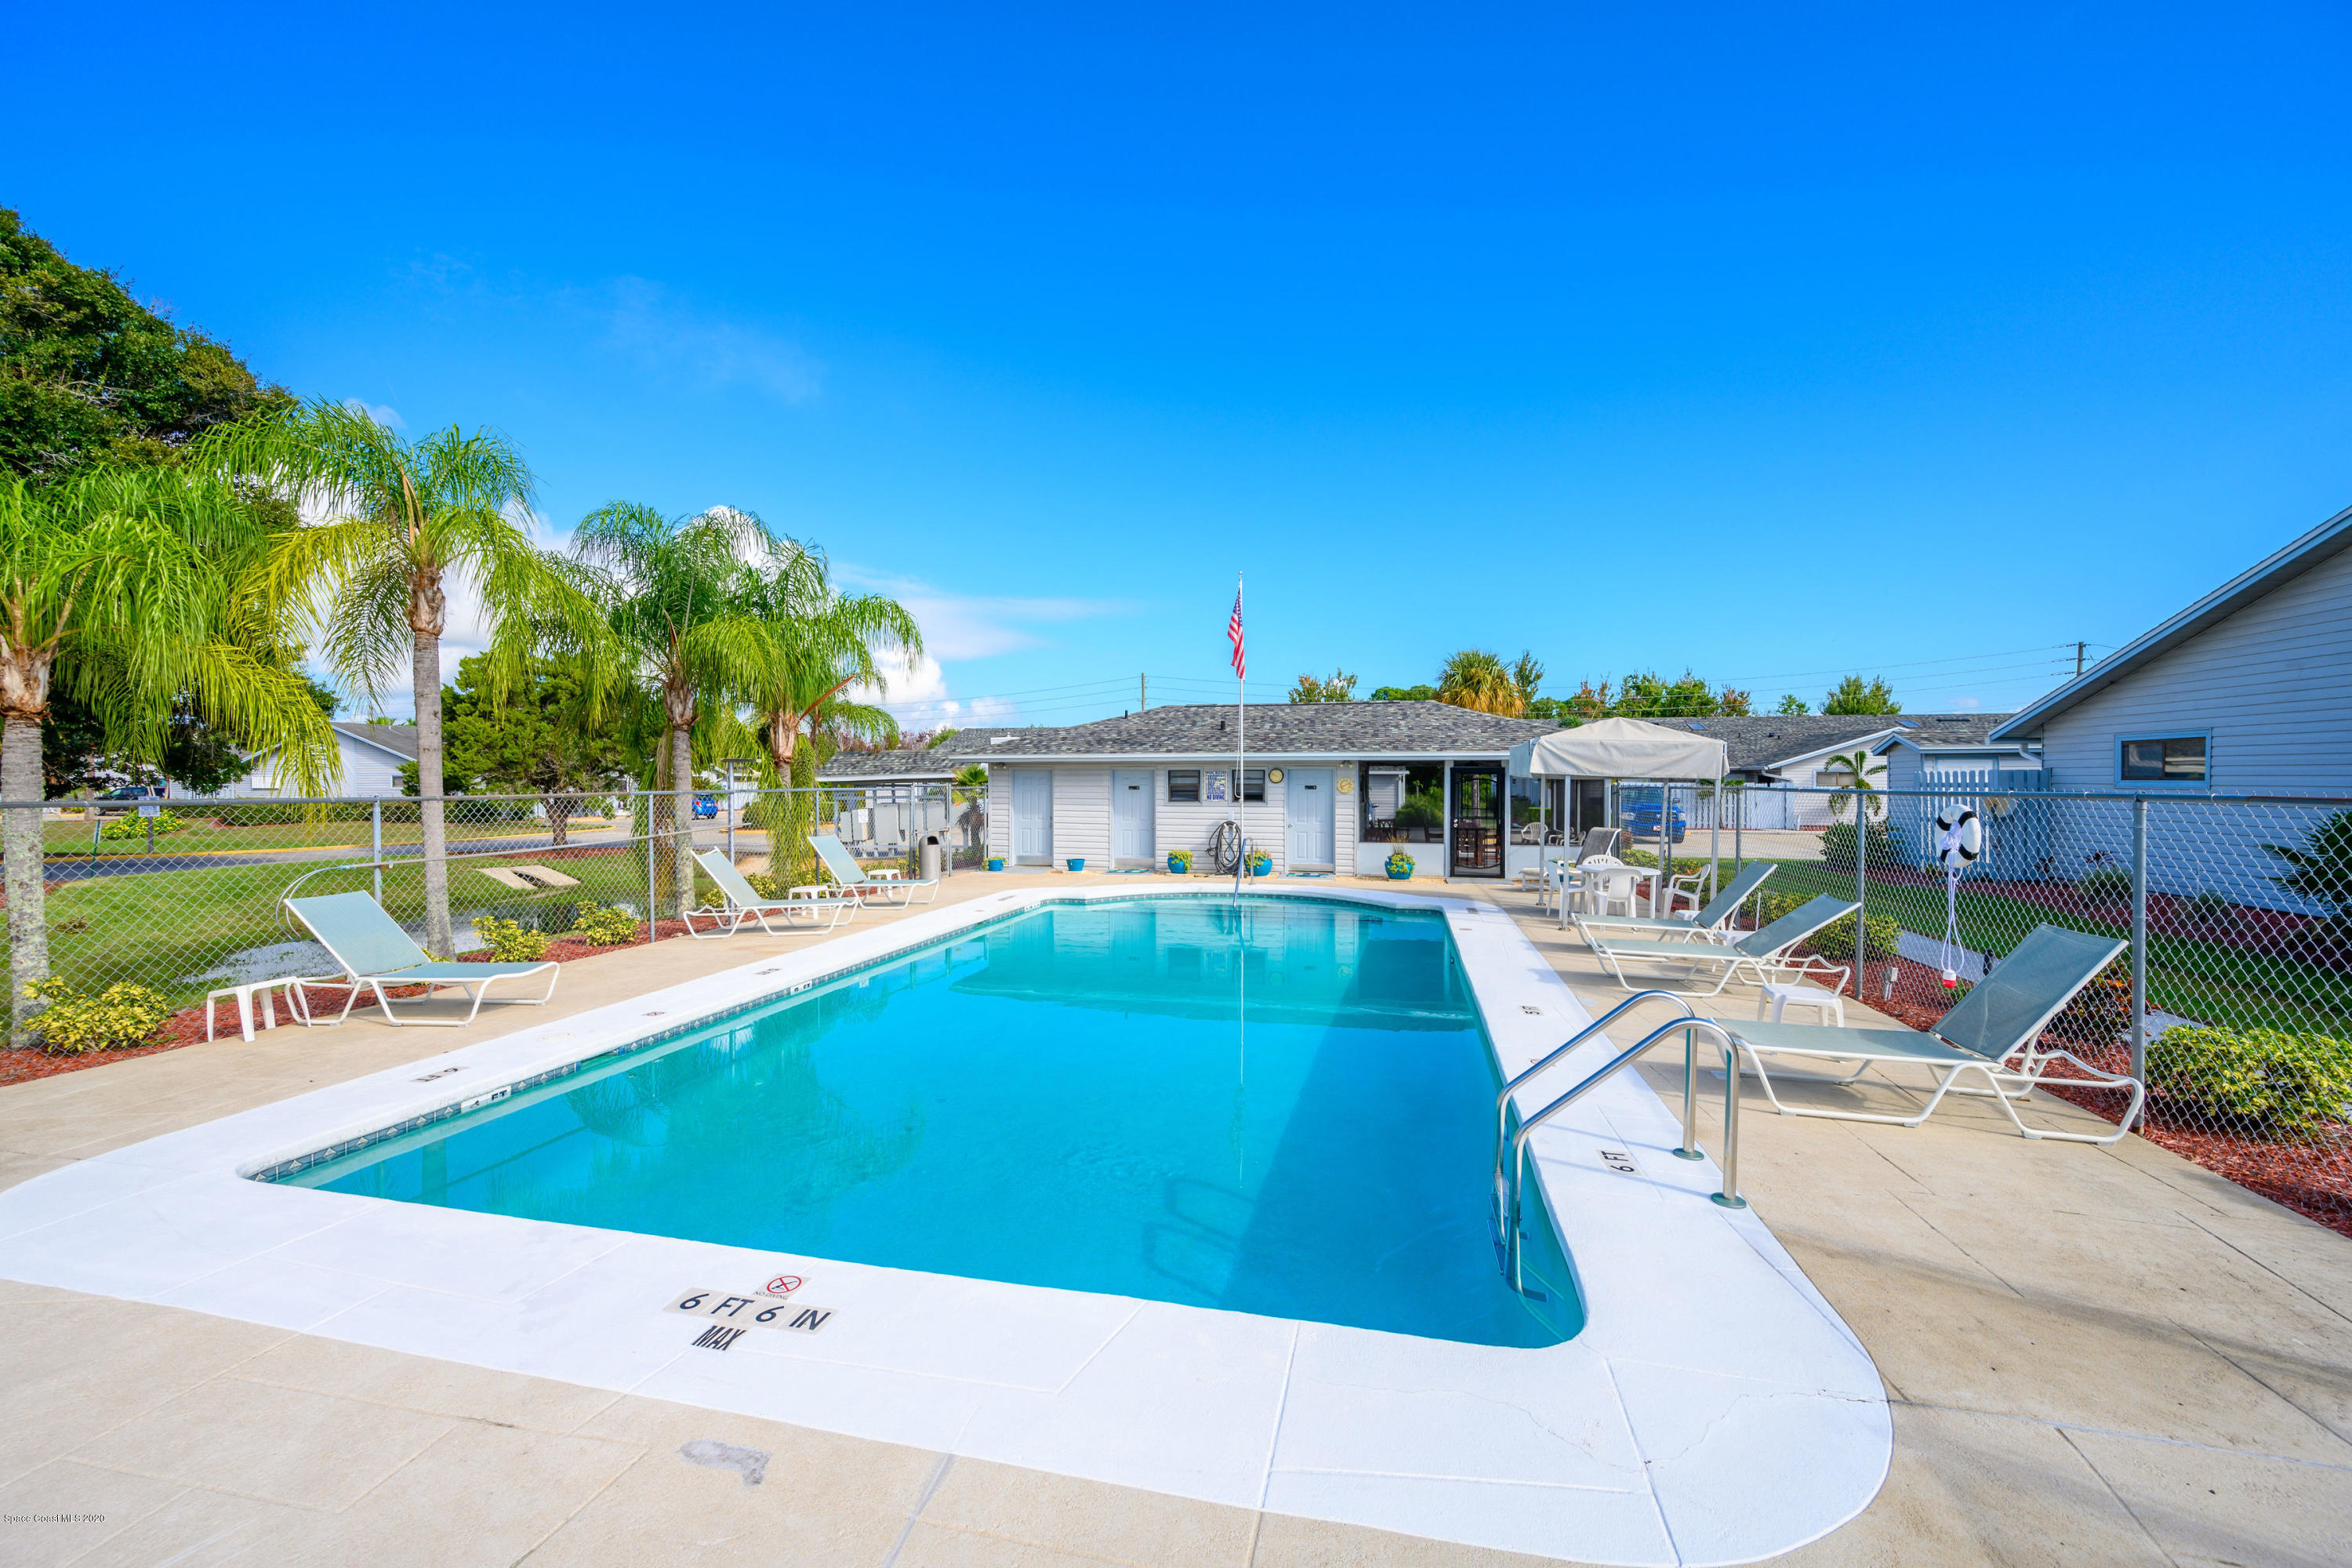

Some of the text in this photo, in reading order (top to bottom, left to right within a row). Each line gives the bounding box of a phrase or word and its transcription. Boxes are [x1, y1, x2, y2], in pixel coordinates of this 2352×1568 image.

[491, 1089, 508, 1101] FT
[1601, 1150, 1629, 1162] FT
[680, 1293, 832, 1330] 6 FT 6 IN
[691, 1325, 746, 1351] MAX
